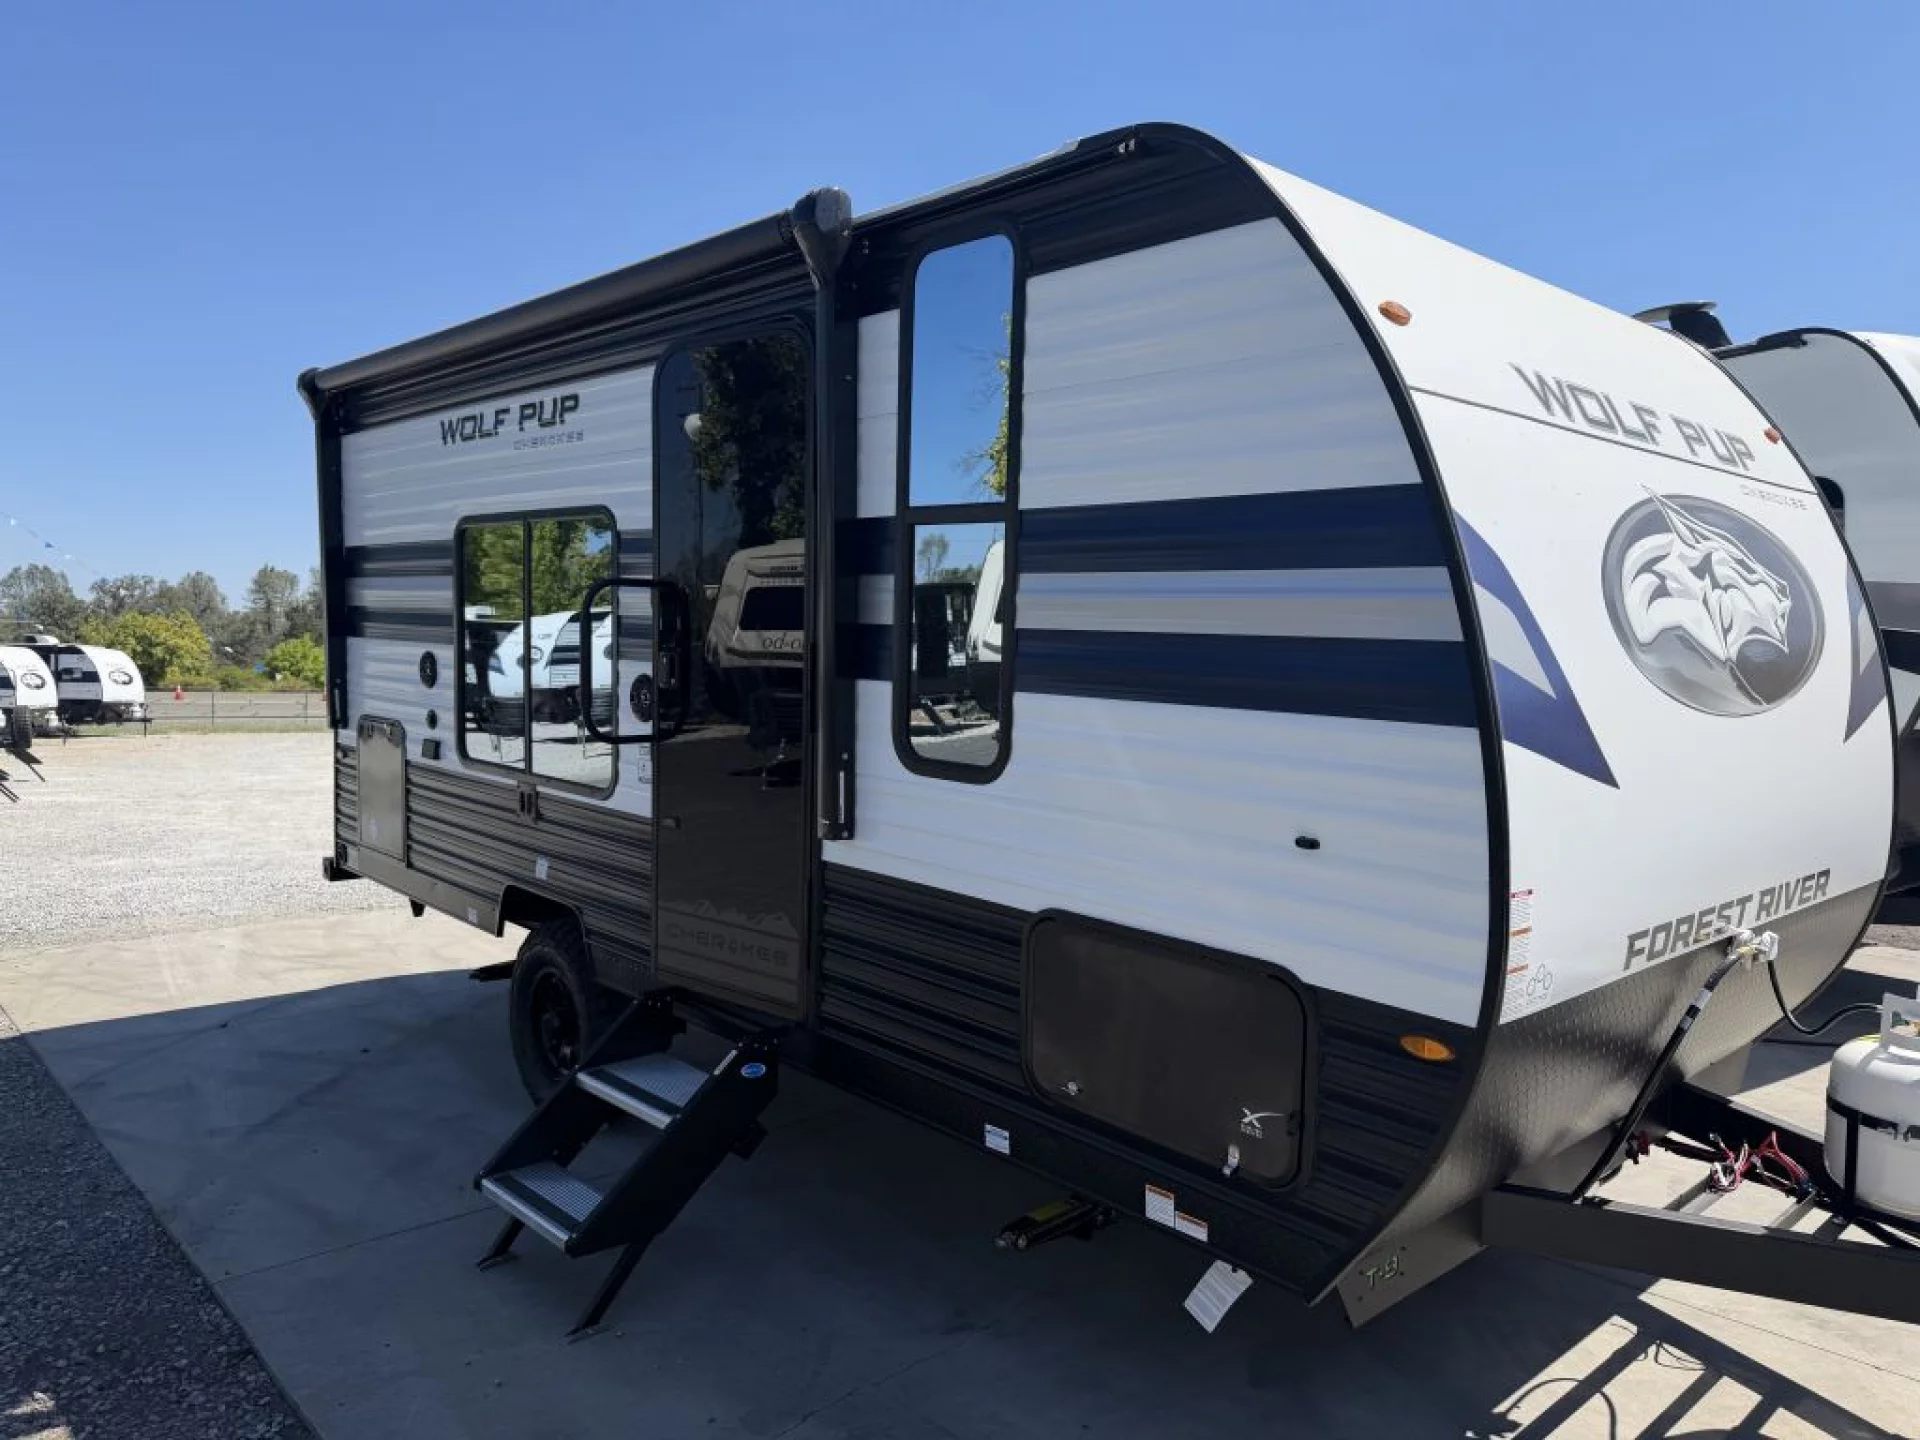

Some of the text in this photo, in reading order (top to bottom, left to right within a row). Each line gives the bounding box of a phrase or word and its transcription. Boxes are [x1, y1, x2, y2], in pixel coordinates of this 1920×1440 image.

[440, 393, 580, 446] WOLF PUP
[1508, 361, 1756, 471] WOLF PUP
[1624, 867, 1831, 971] FOREST RIVER
